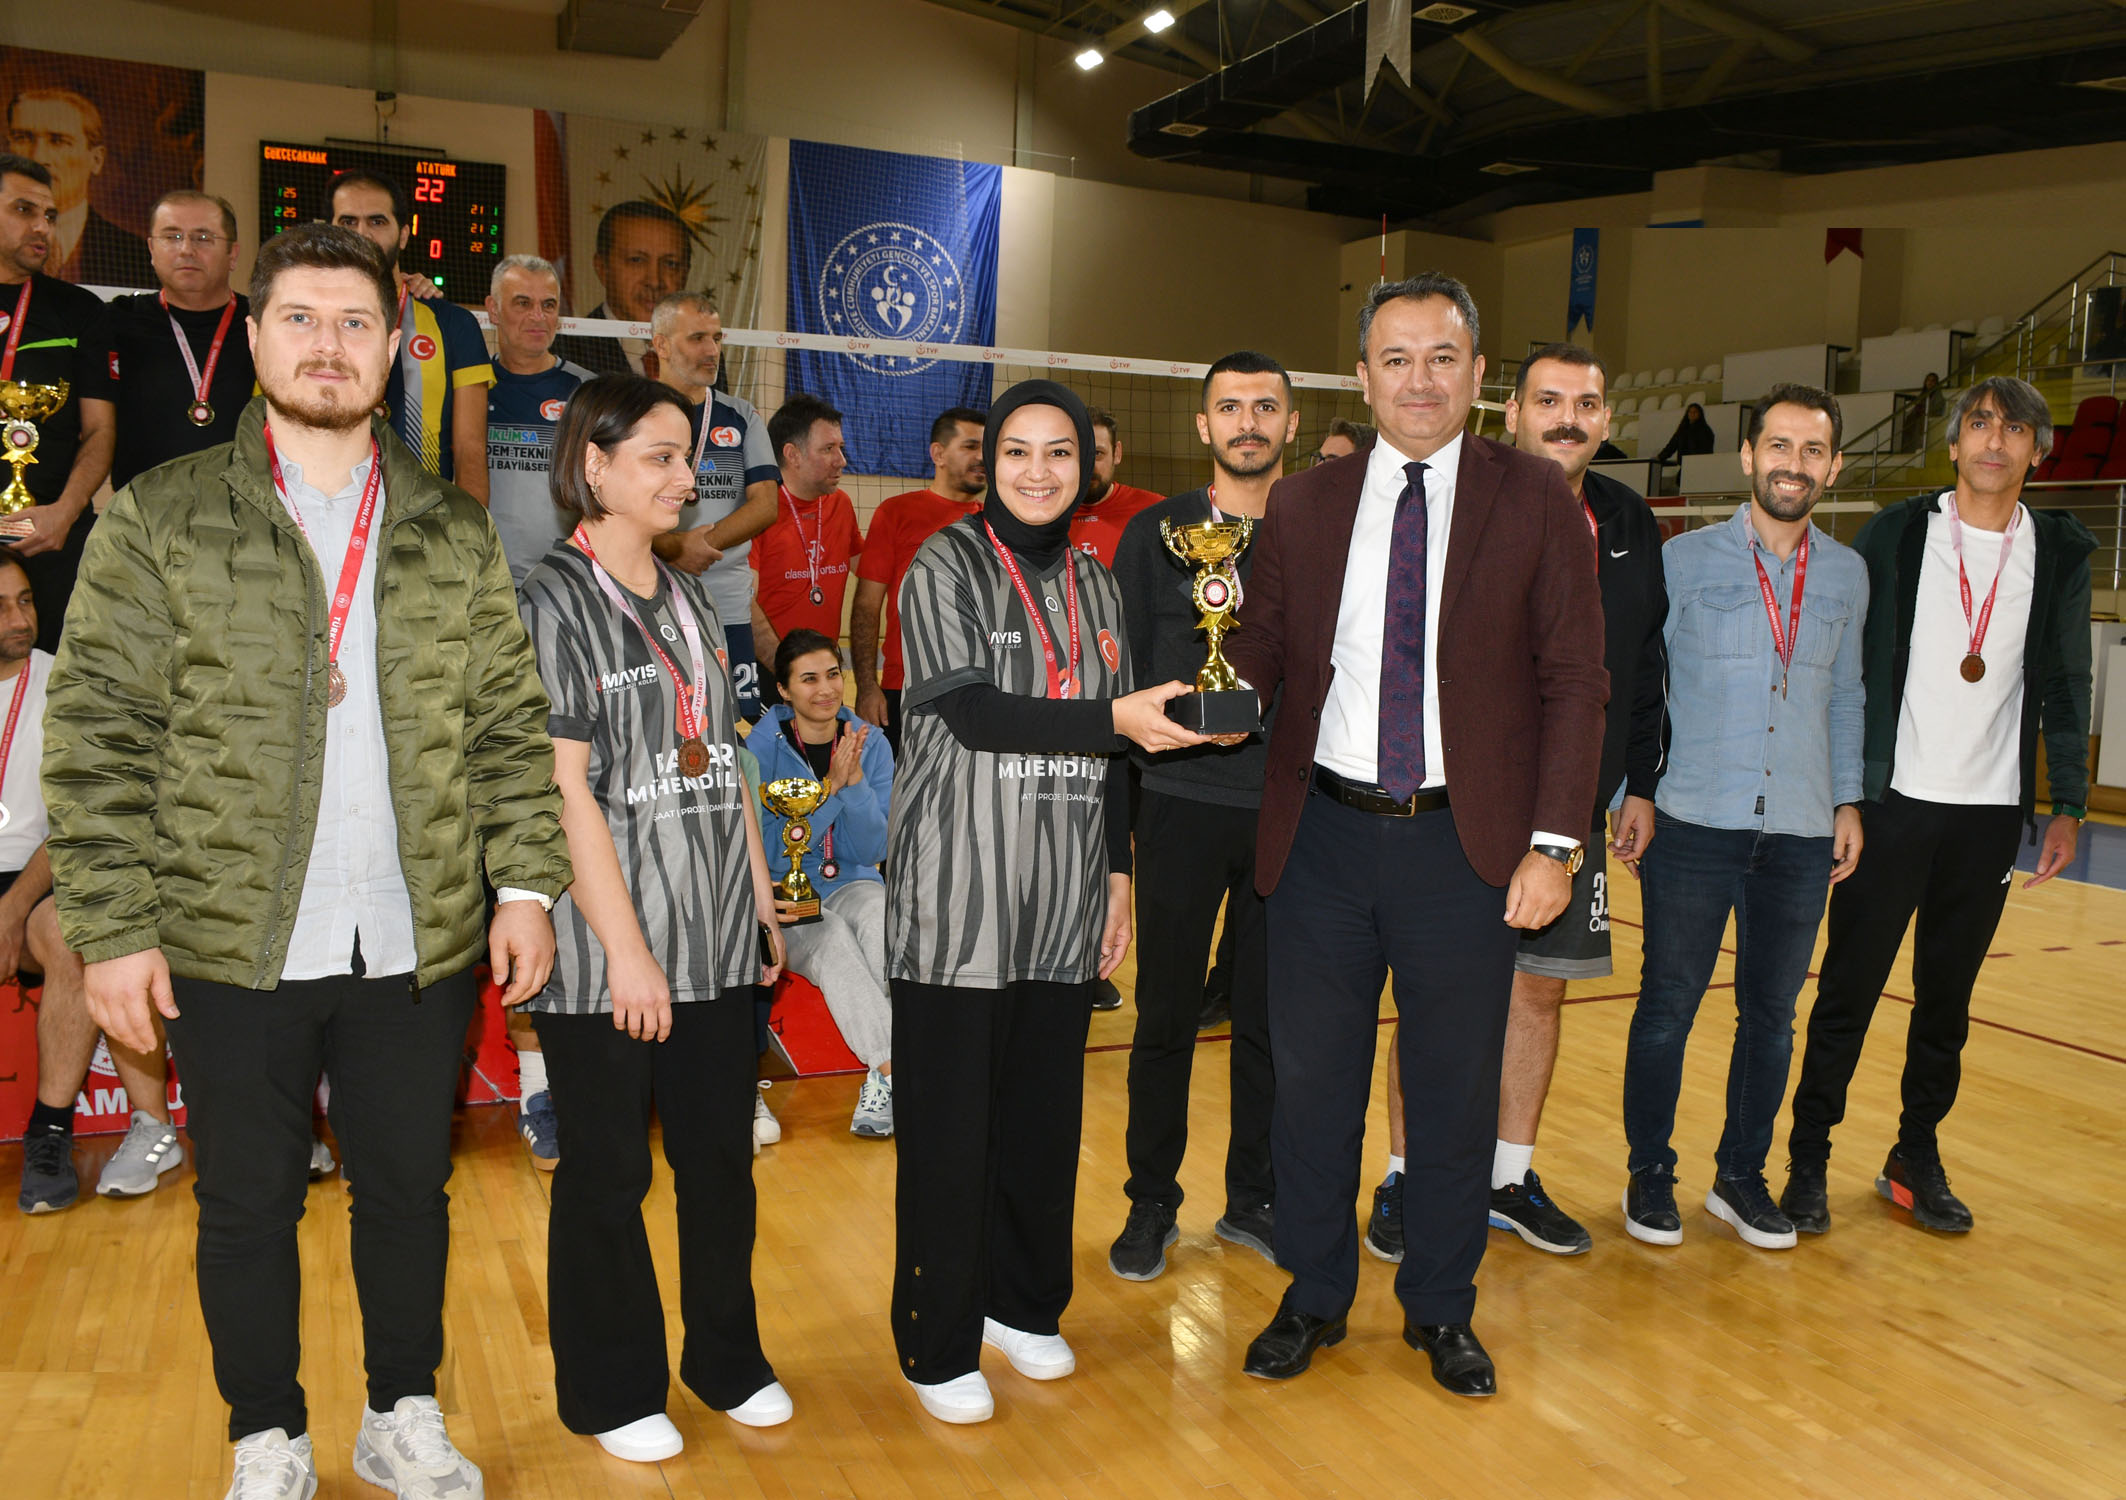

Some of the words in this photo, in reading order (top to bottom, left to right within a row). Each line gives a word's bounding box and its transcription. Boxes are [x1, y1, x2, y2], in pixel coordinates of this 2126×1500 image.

[283, 187, 297, 198] 25
[415, 178, 445, 202] 22
[274, 206, 282, 217] 2
[283, 207, 297, 218] 25
[470, 204, 484, 215] 21
[493, 207, 498, 216] 1
[412, 214, 418, 236] 1
[470, 223, 484, 234] 21
[490, 224, 498, 235] 2
[430, 240, 442, 259] 0
[470, 242, 483, 253] 22
[490, 244, 497, 254] 3
[847, 252, 880, 309] CUMHURİYETİ
[882, 250, 921, 268] GENÇLİK
[920, 265, 932, 279] VE
[928, 279, 939, 305] SPOR
[698, 459, 716, 471] SA
[359, 485, 376, 529] BAKANLIĞI
[1000, 546, 1016, 573] GENÇLİK
[1014, 575, 1037, 616] CUMHURİYETİ
[1035, 617, 1049, 643] TÜRKİYE
[661, 653, 675, 671] SPOR
[679, 683, 690, 716] GENÇLİK
[656, 743, 733, 777] BAAR
[1038, 793, 1062, 801] PROJE
[681, 804, 707, 816] PROJE
[1590, 872, 1609, 917] 3
